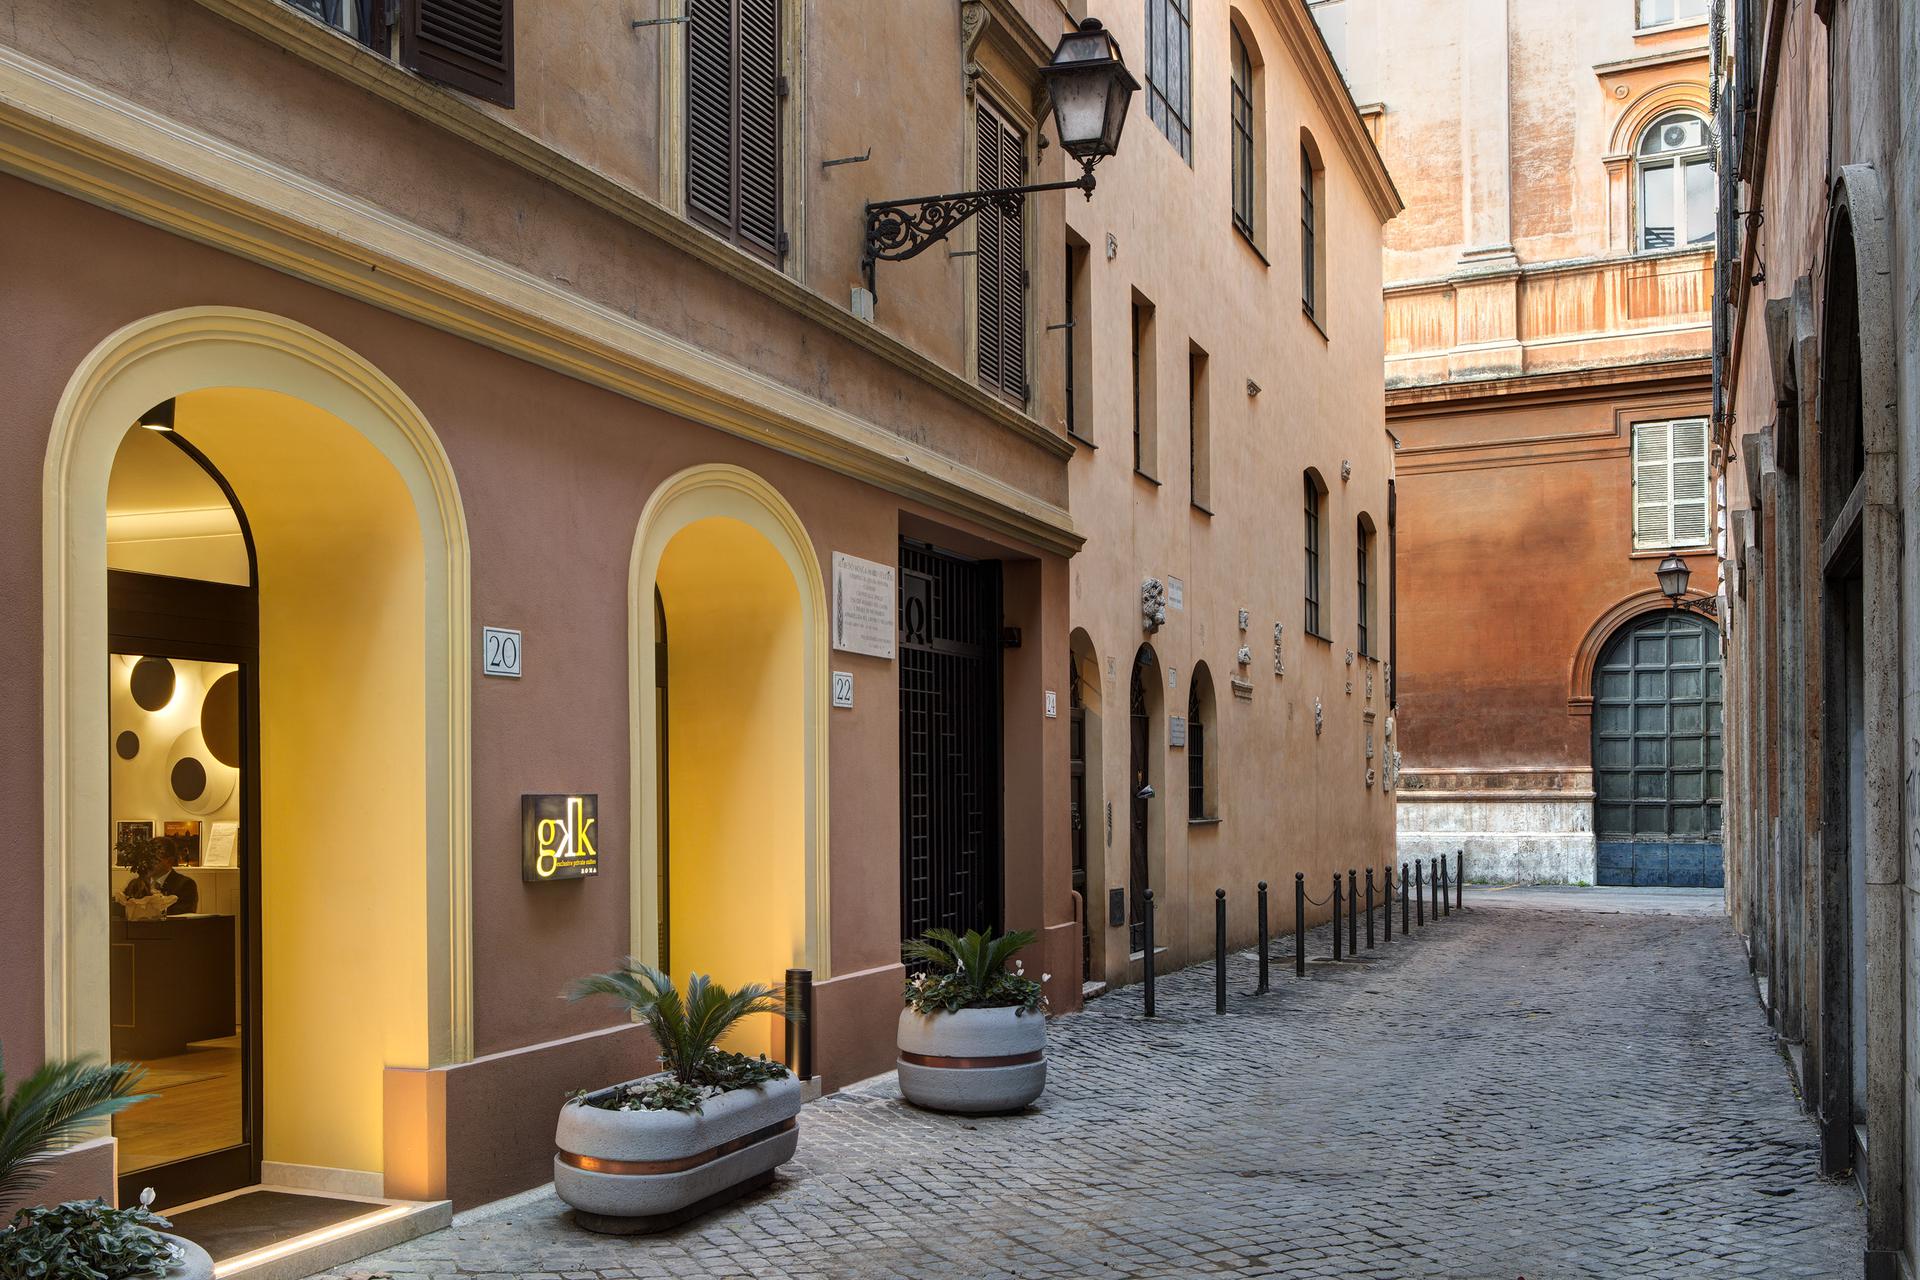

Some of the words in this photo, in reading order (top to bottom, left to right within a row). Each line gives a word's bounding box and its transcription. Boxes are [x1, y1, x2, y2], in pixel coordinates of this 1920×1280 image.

[489, 635, 517, 669] 20
[836, 678, 851, 701] 22
[1047, 695, 1055, 713] 24
